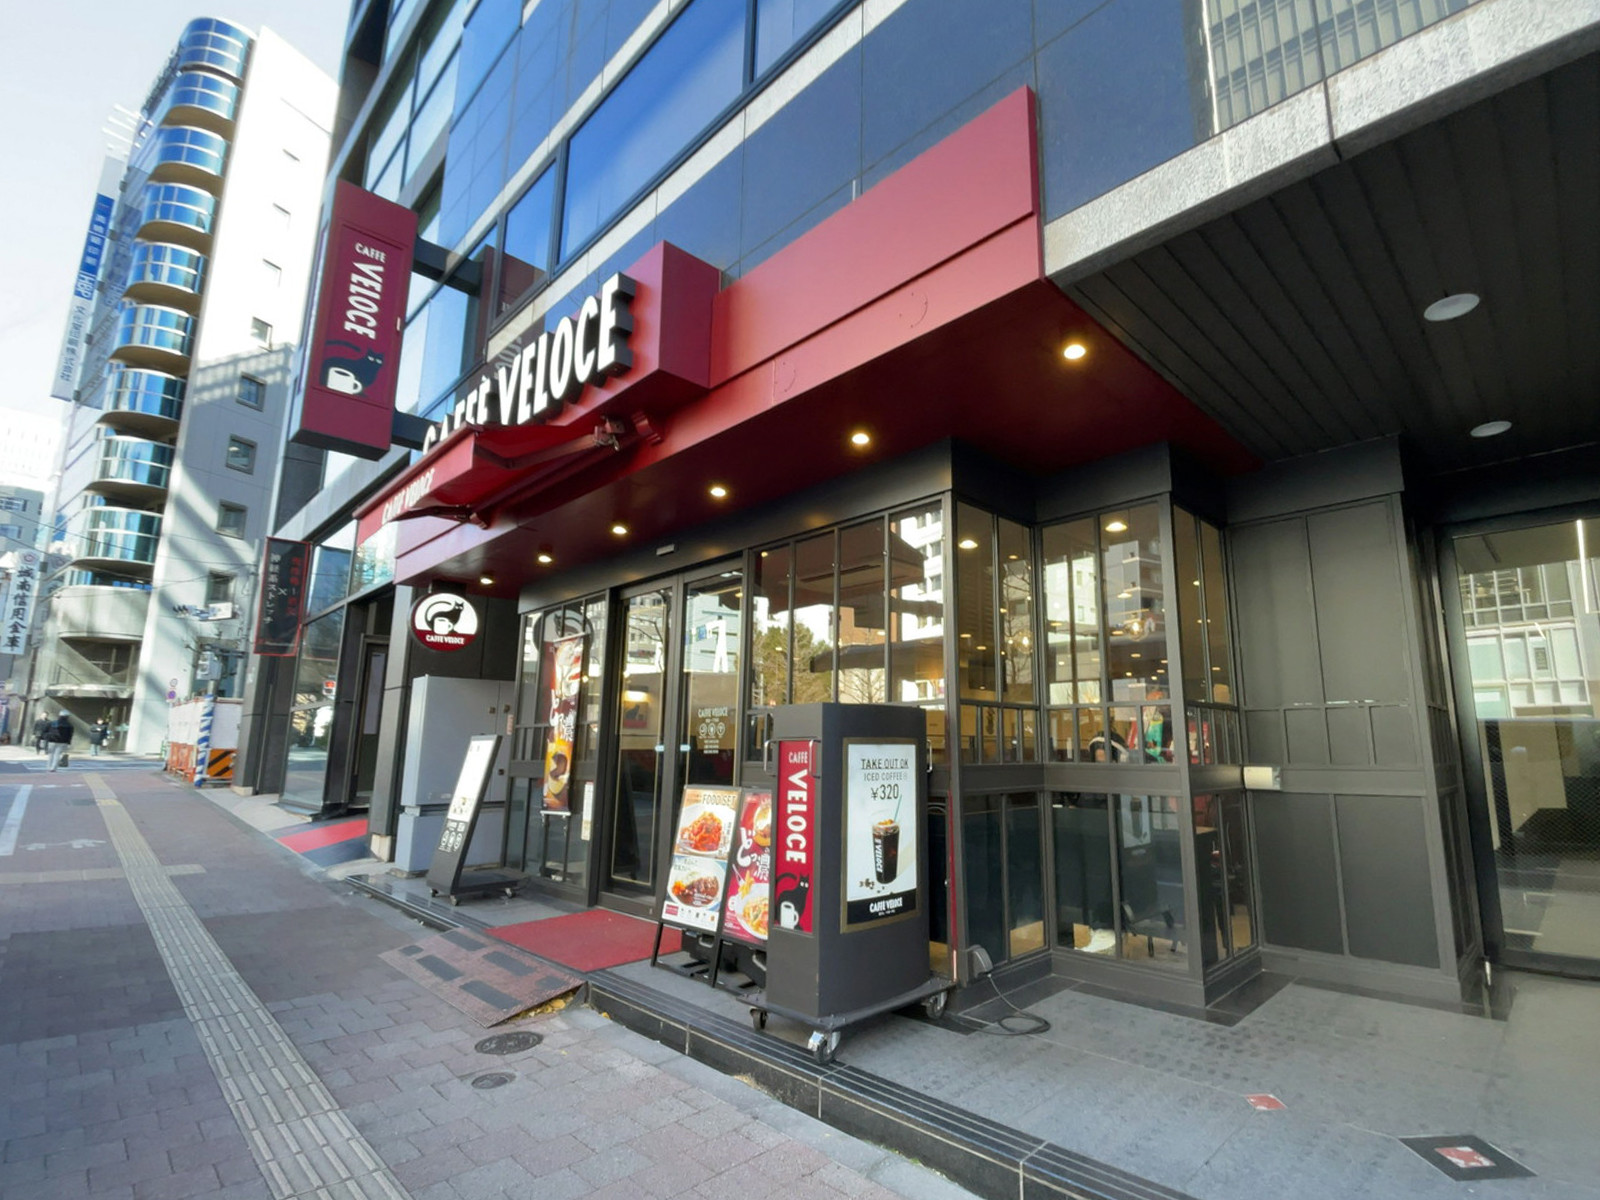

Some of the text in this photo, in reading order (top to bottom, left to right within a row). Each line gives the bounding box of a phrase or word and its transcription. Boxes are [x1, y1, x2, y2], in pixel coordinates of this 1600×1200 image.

[344, 262, 384, 339] VELOCE
[498, 272, 619, 426] VELOCE
[3, 565, 34, 651] 城南信用金庫
[861, 758, 909, 769] TAKE OUT OK
[864, 772, 880, 781] ICED
[881, 771, 903, 781] COFFEE
[702, 794, 721, 805] FOOD
[871, 783, 900, 801] ¥320
[786, 769, 808, 864] VELOCE
[886, 896, 903, 909] VELOCE
